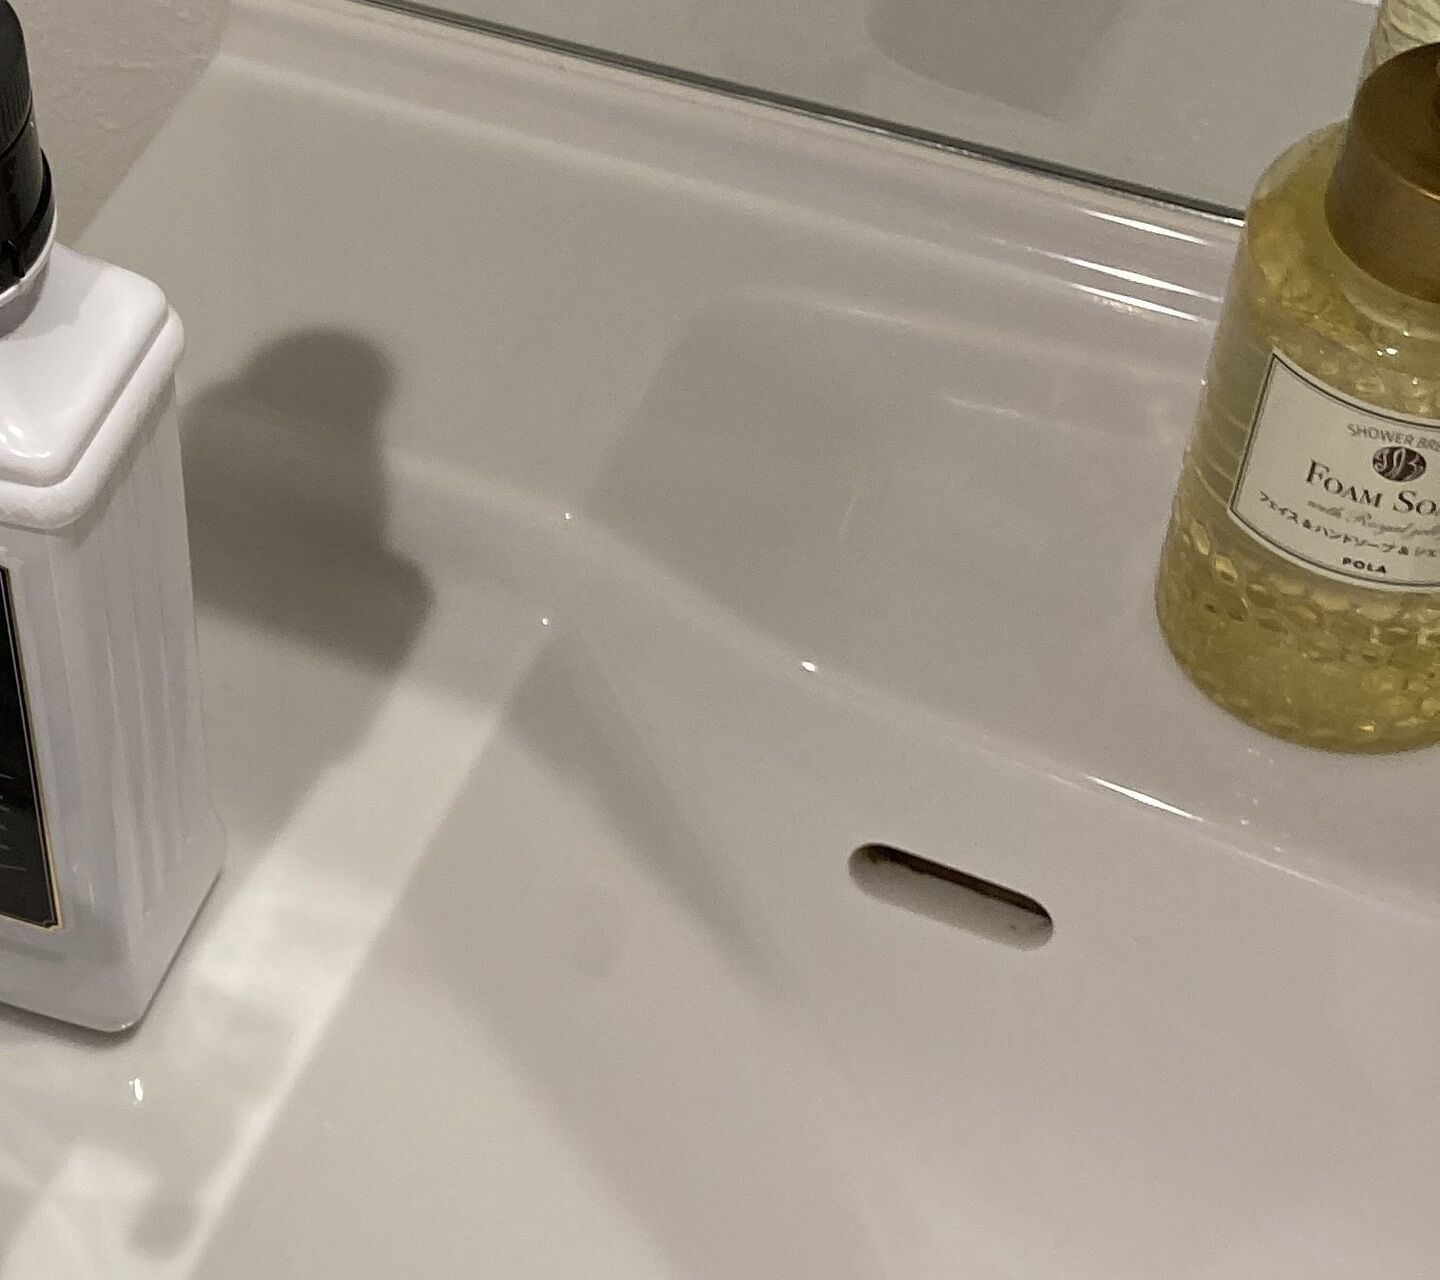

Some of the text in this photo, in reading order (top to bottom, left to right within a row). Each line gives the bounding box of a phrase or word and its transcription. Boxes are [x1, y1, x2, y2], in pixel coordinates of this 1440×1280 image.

[1347, 423, 1415, 446] SHOWER
[1306, 459, 1440, 517] FOAM SO
[1342, 557, 1387, 575] POLA
